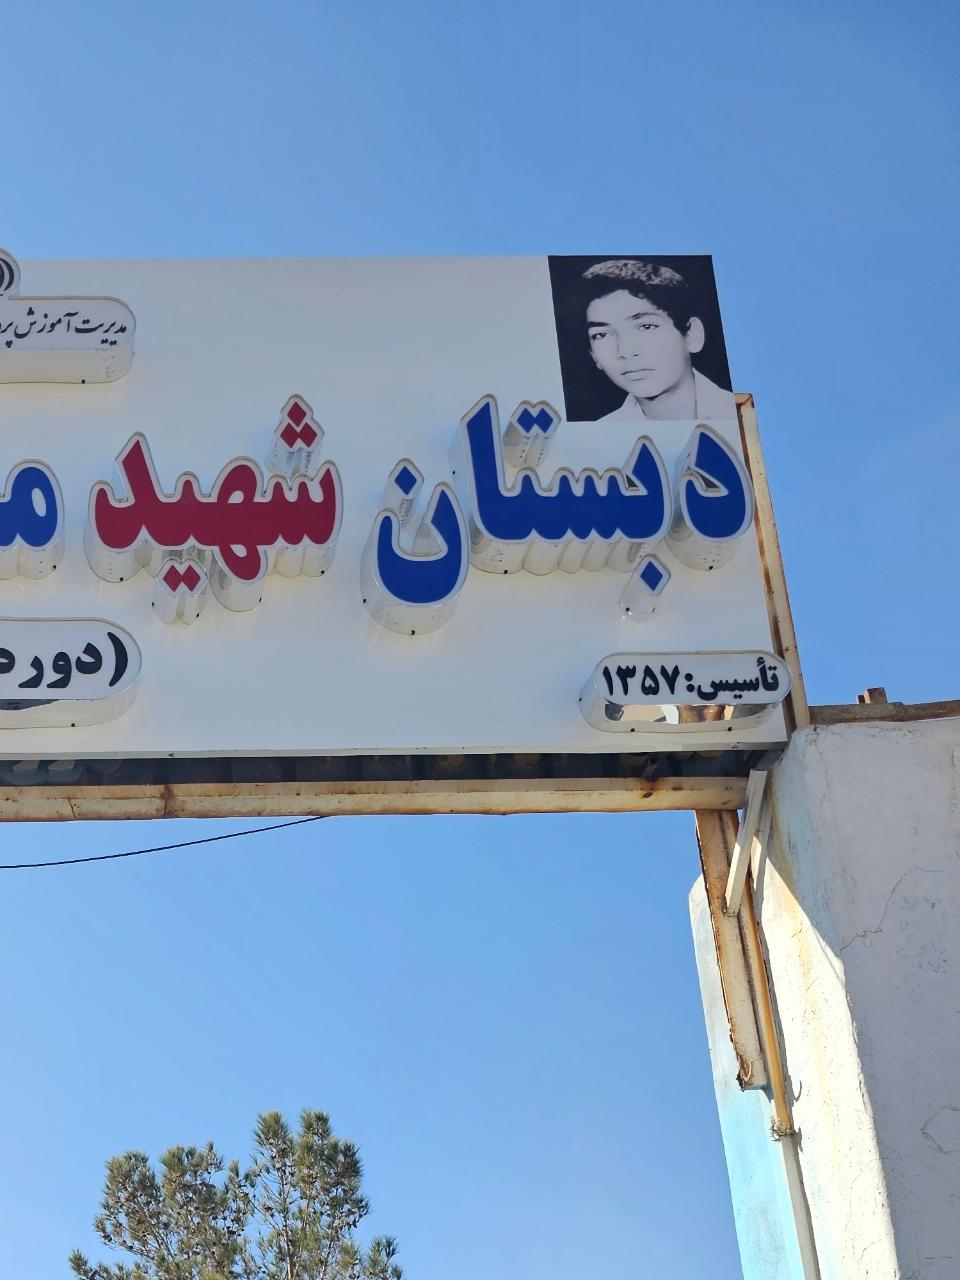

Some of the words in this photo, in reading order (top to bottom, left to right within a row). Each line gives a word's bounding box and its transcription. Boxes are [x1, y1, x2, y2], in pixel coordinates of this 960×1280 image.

[13, 306, 79, 339] آموزش
[74, 318, 127, 346] مدیریت
[94, 400, 337, 593] شهید
[376, 401, 746, 604] دبستان
